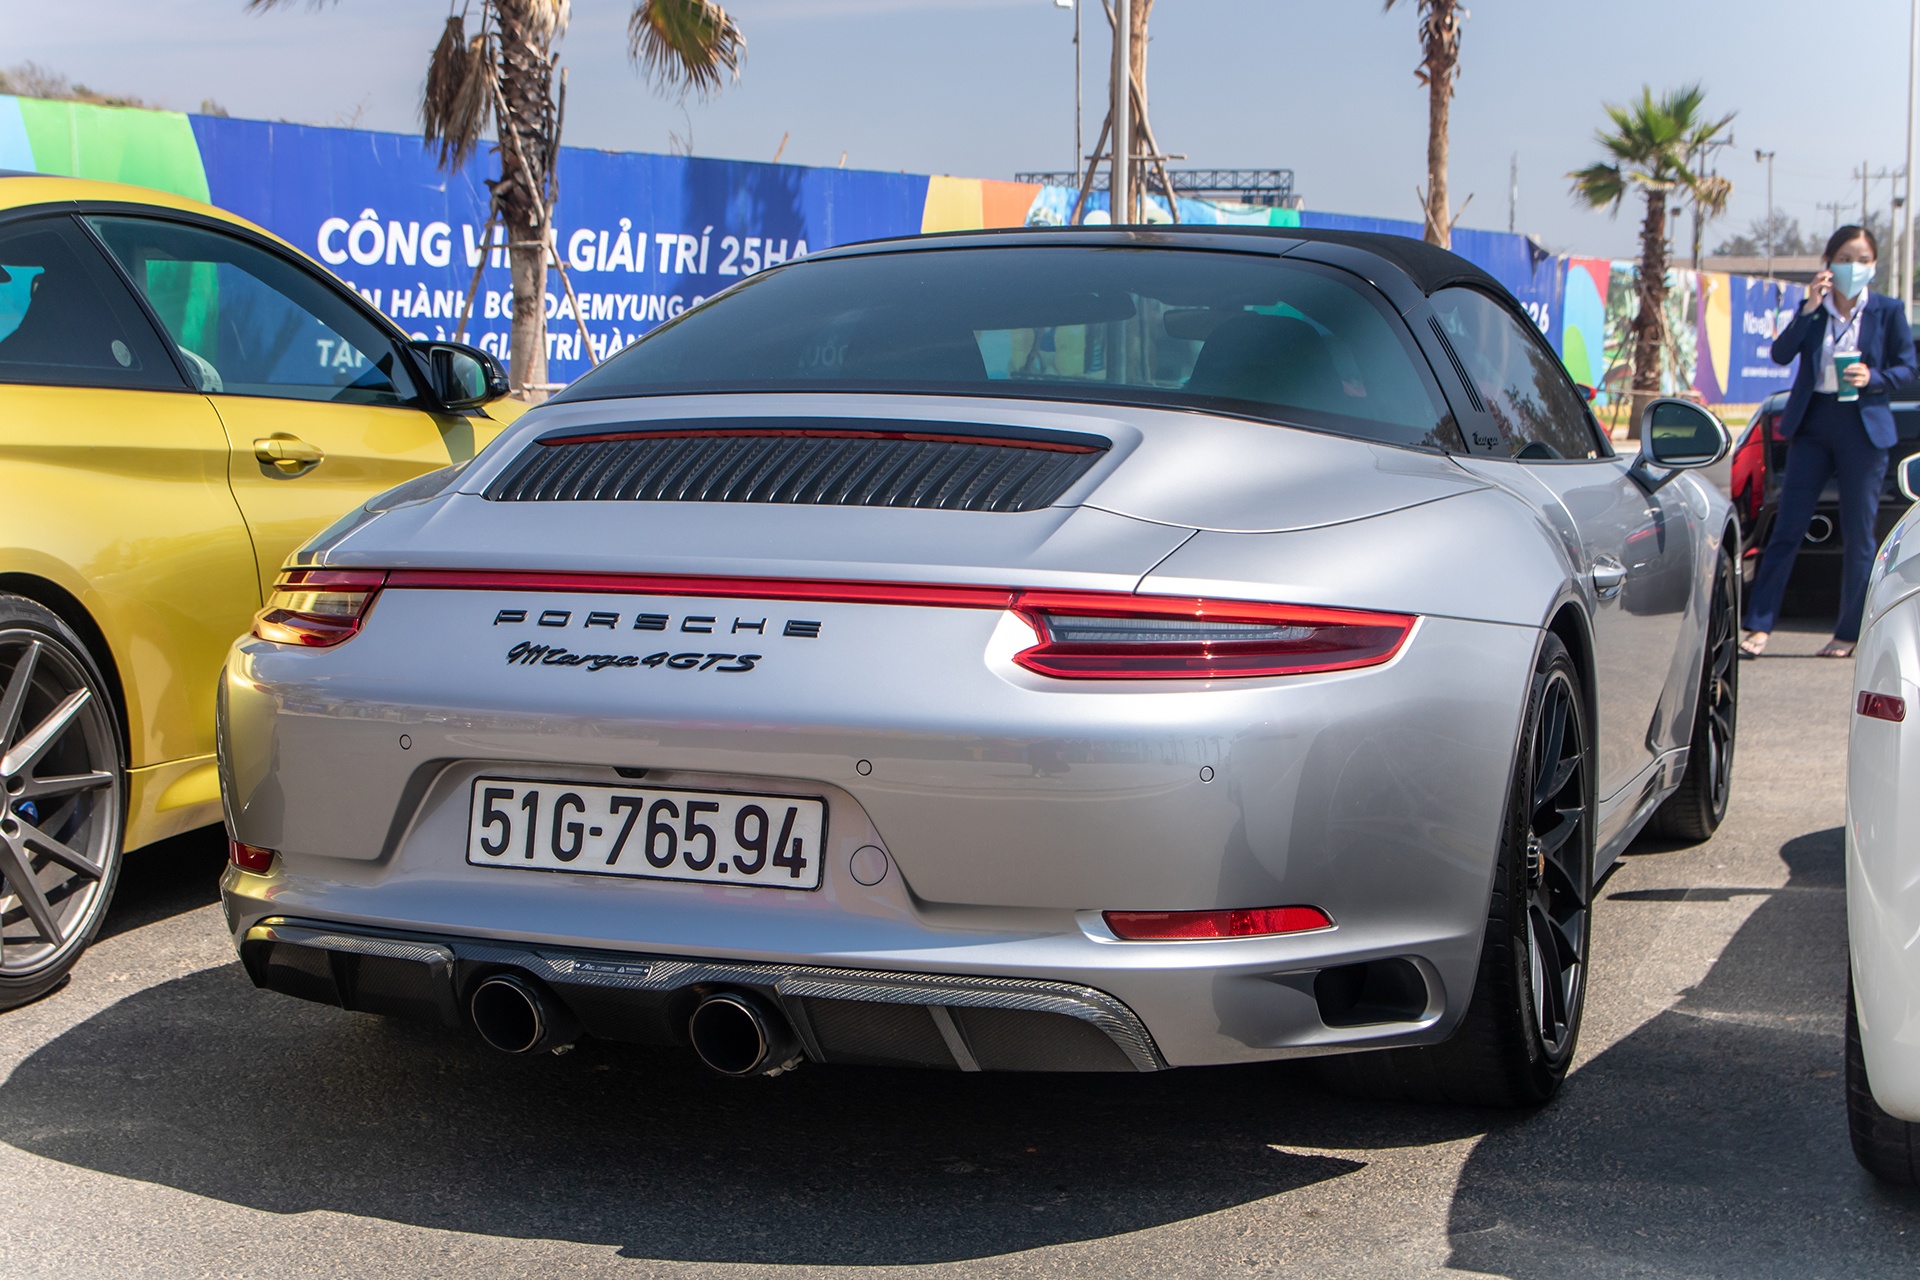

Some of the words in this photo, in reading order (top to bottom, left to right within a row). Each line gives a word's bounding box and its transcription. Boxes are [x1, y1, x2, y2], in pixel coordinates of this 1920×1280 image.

[317, 208, 452, 268] CÔNG
[462, 224, 558, 268] VI
[568, 217, 648, 272] GIẢI
[655, 225, 714, 274] TRÍ
[390, 282, 474, 319] HÀNH
[493, 609, 824, 638] PORSCHE
[480, 788, 807, 878] 51G-765.94
